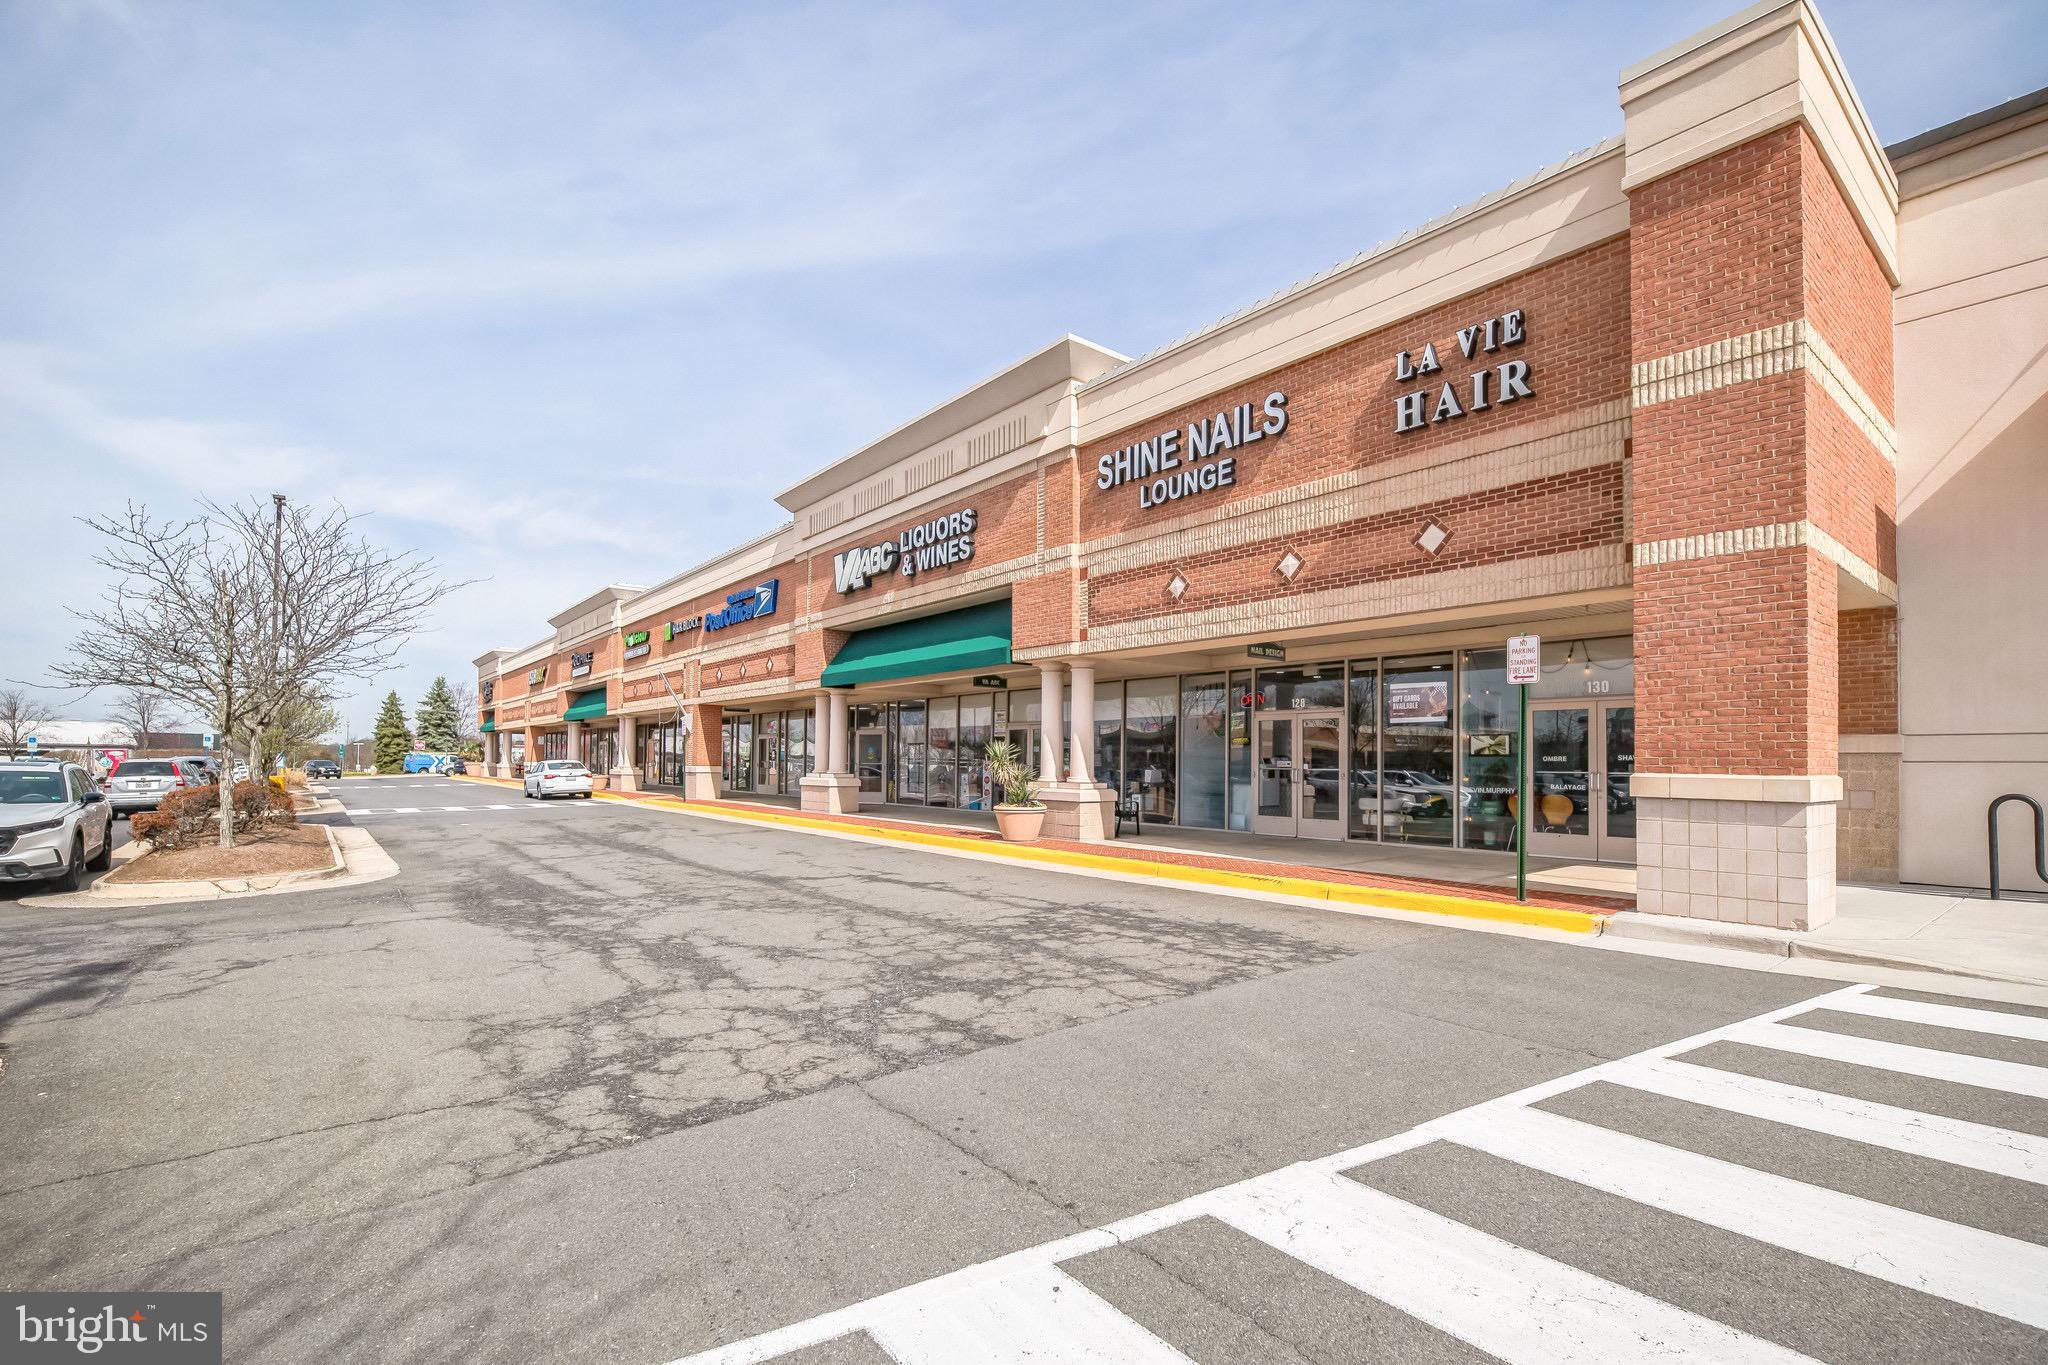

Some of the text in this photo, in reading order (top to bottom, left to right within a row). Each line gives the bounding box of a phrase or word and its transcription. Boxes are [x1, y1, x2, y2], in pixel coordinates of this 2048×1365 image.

[1396, 309, 1524, 381] LA VIE
[1394, 359, 1534, 433] HAIR
[1098, 392, 1288, 490] SHINE NAILS
[1140, 457, 1235, 509] LOUNGE
[900, 508, 977, 553] LIQUORS
[901, 535, 974, 577] & WINES
[1250, 646, 1284, 657] NAIL DESIGN
[1509, 666, 1537, 675] FIRE LANE
[1587, 680, 1609, 693] 130
[1241, 692, 1265, 705] OPN
[1291, 698, 1306, 708] 128
[1392, 694, 1421, 703] GIFT CARDS
[1392, 702, 1419, 710] AVAILABLE
[1466, 786, 1516, 794] VIN.MURPHY
[1550, 783, 1587, 791] BALAYAGE
